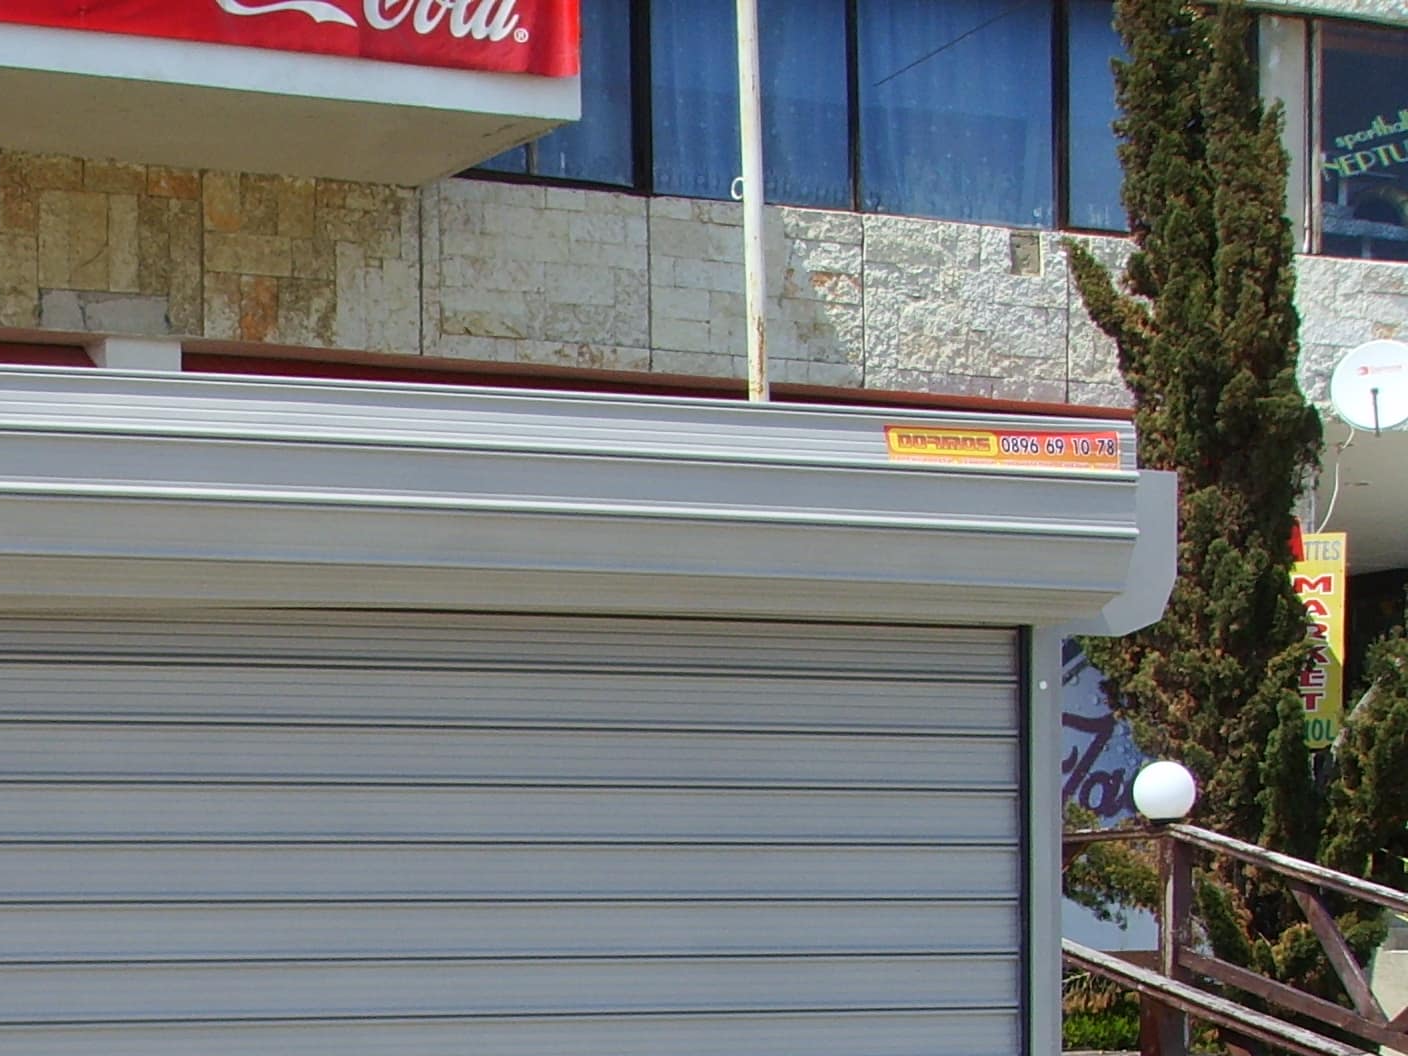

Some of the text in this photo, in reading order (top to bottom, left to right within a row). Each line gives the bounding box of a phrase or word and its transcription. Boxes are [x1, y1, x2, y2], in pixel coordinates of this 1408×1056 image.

[1000, 436, 1040, 456] 0896
[1045, 437, 1065, 455] 69
[1072, 438, 1091, 456] 10
[1096, 438, 1116, 456] 78
